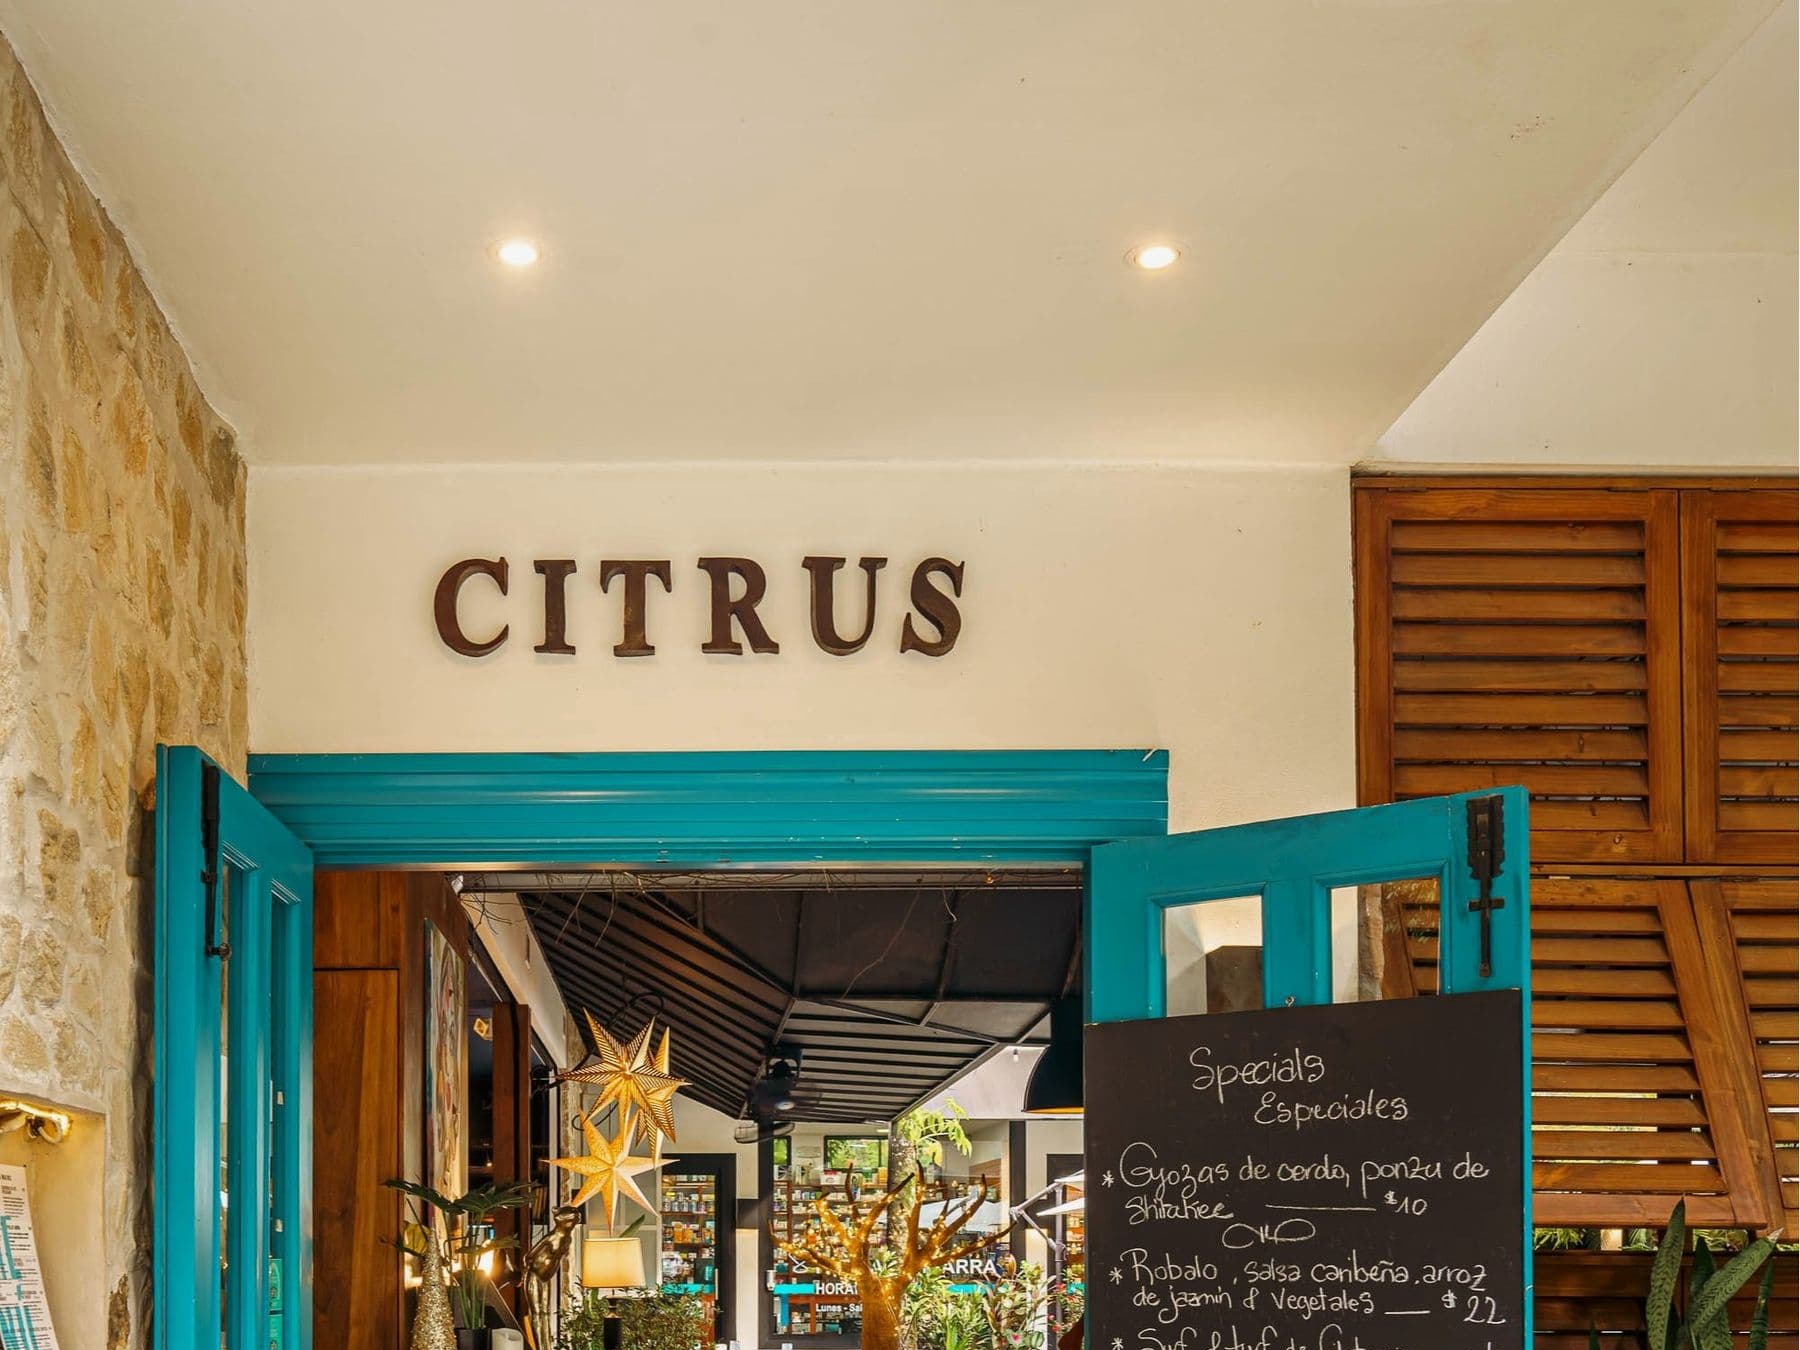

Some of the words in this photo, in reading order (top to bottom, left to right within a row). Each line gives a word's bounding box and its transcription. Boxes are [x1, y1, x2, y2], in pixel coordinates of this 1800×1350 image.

[434, 556, 966, 658] CITRUS
[1189, 1046, 1325, 1104] Specials
[1253, 1089, 1409, 1131] Especiales
[1119, 1141, 1230, 1200] Gyozas
[1240, 1154, 1271, 1181] de
[1360, 1157, 1442, 1199] ponzu
[1453, 1152, 1490, 1180] de
[1383, 1190, 1428, 1216] $10
[943, 1259, 998, 1274] ARRA
[1423, 1264, 1487, 1292] arroz
[815, 1282, 858, 1295] HORA
[1132, 1286, 1161, 1307] de
